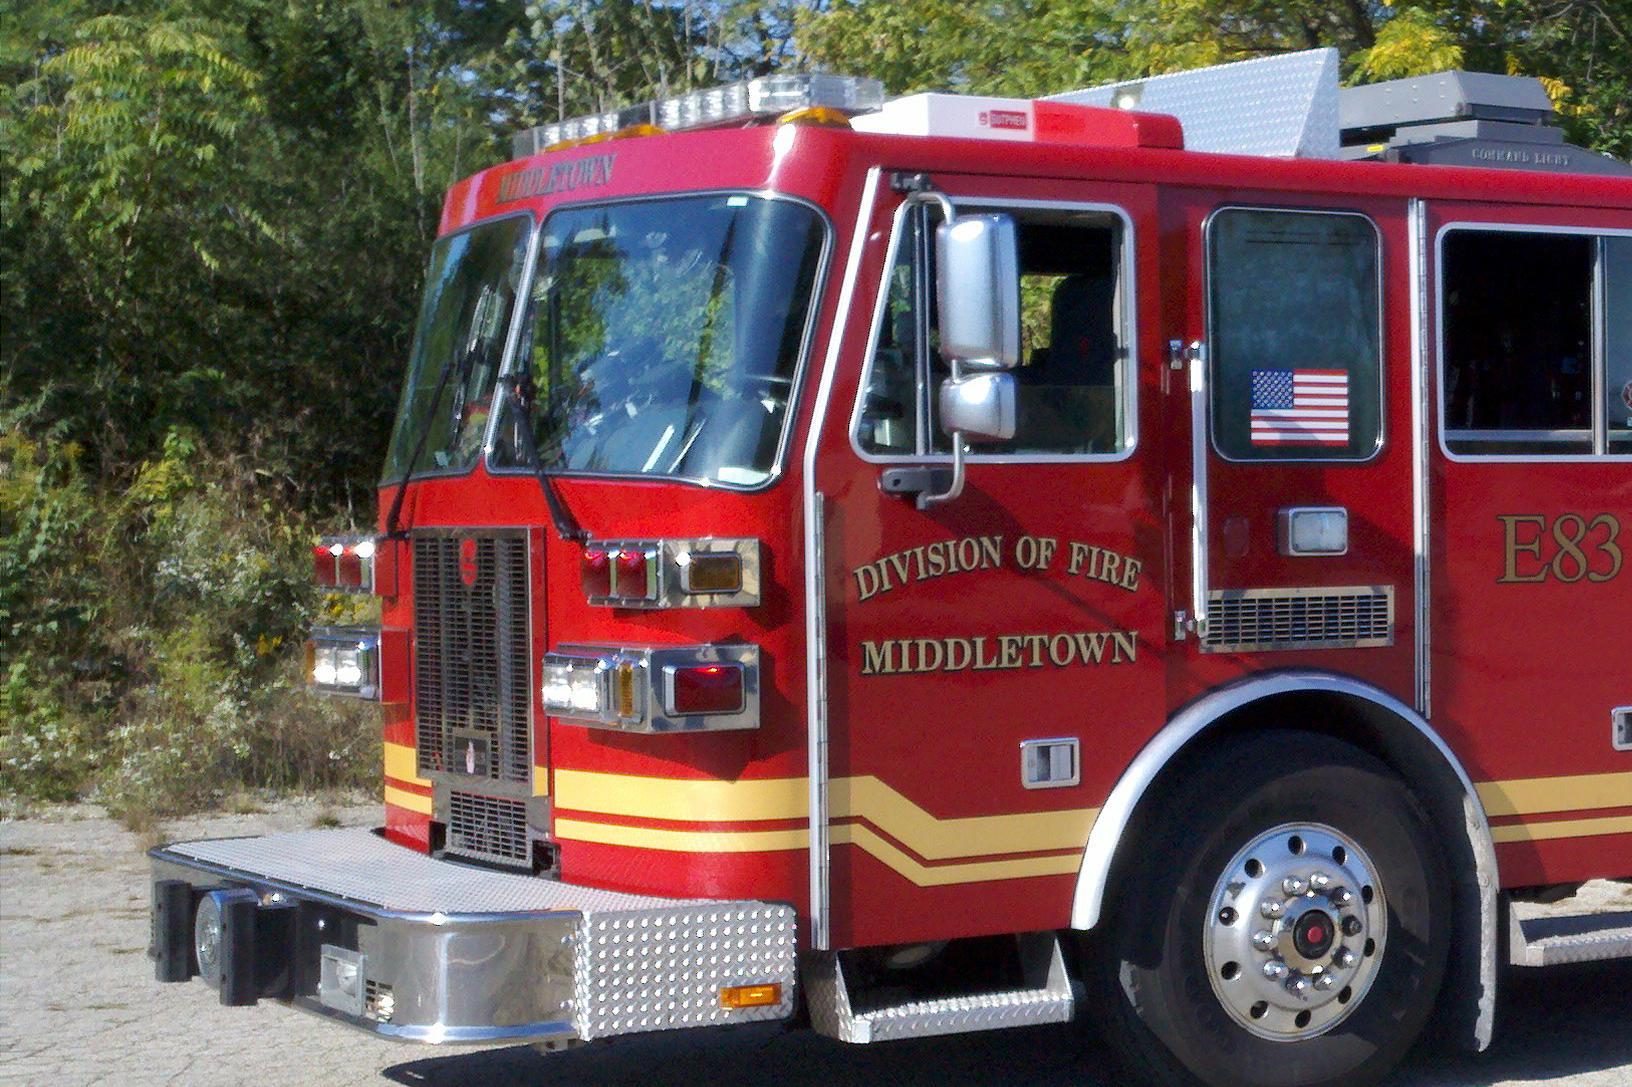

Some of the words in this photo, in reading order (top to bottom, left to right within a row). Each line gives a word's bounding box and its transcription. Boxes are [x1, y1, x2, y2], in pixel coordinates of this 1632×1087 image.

[496, 151, 618, 204] MIDDLETOWN
[853, 535, 1003, 601] DIVISION
[1015, 535, 1057, 570] OF
[1068, 541, 1142, 592] FIRE
[1496, 512, 1623, 584] E83
[860, 630, 1139, 675] MIDDLETOWN
